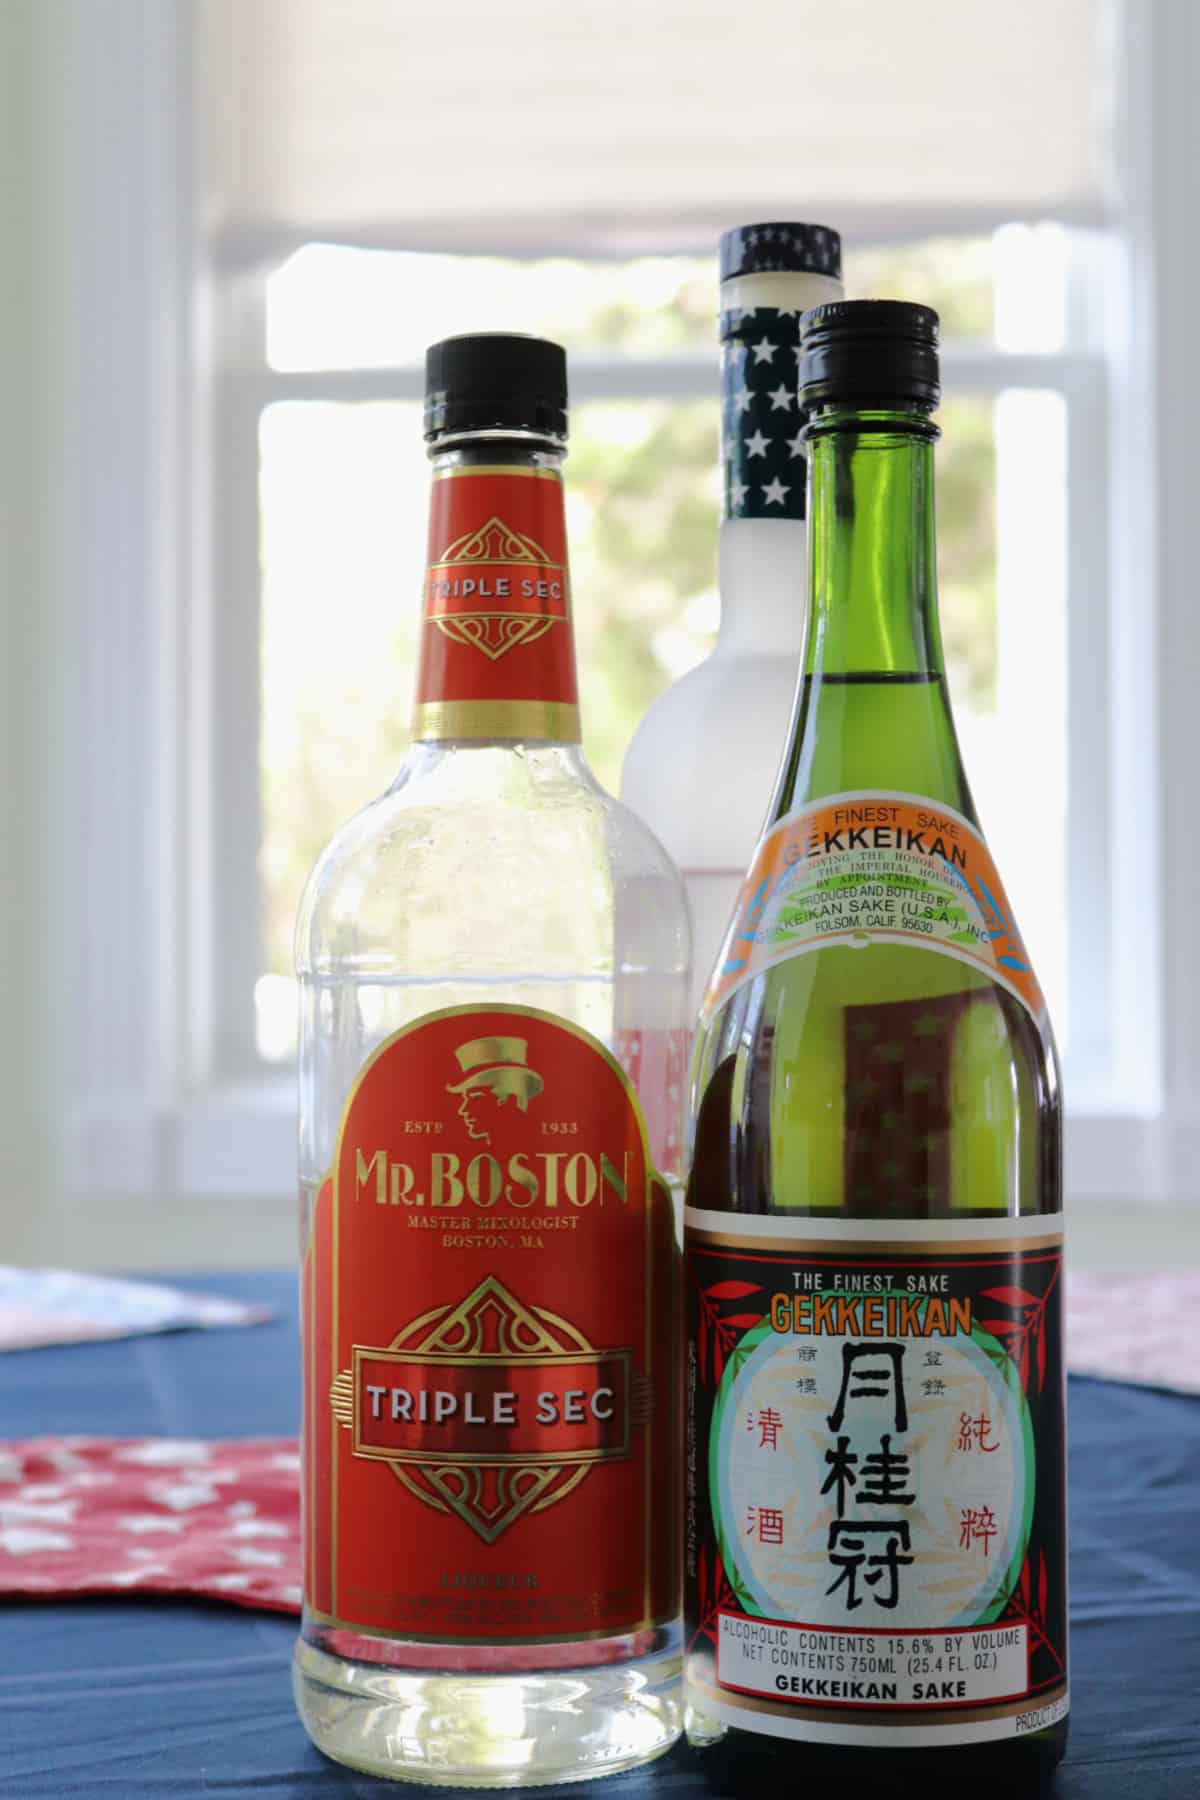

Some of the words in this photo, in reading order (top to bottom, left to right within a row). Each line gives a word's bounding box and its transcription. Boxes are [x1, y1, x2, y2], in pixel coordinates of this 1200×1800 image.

[431, 578, 511, 598] TRIPLE
[520, 579, 561, 600] SEC
[834, 807, 900, 824] FINEST
[916, 812, 960, 840] SAKE
[784, 826, 968, 868] GEKKEIKAN
[849, 899, 896, 914] SAKE
[860, 886, 884, 897] AND
[886, 886, 935, 904] BOTTLED
[936, 894, 950, 908] BY
[902, 917, 934, 933] 95630
[407, 1216, 471, 1229] MASTER
[477, 1216, 578, 1230] MIXOLOGIST
[520, 1235, 544, 1248] MA
[792, 1272, 822, 1291] THE
[834, 1273, 894, 1292] FINEST
[906, 1274, 949, 1293] SAKE
[769, 1292, 972, 1336] GEKKEIKAN
[366, 1386, 517, 1425] TRIPLE
[535, 1387, 614, 1424] SEC
[820, 1342, 917, 1610] 月桂冠
[440, 1570, 539, 1589] LIQUEUR
[723, 1619, 789, 1648] ALCOHOLIC
[799, 1633, 875, 1654] CONTENTS
[887, 1638, 934, 1655] 15.6%
[945, 1637, 962, 1652] BY
[972, 1630, 1020, 1650] VOLUME
[742, 1643, 764, 1661] NET
[771, 1648, 844, 1672] CONTENTS
[851, 1656, 897, 1673] 750ML
[907, 1656, 943, 1676] (25.4
[948, 1656, 969, 1672] FL.
[775, 1675, 897, 1700] GEKKEIKAN
[912, 1681, 967, 1698] SAKE
